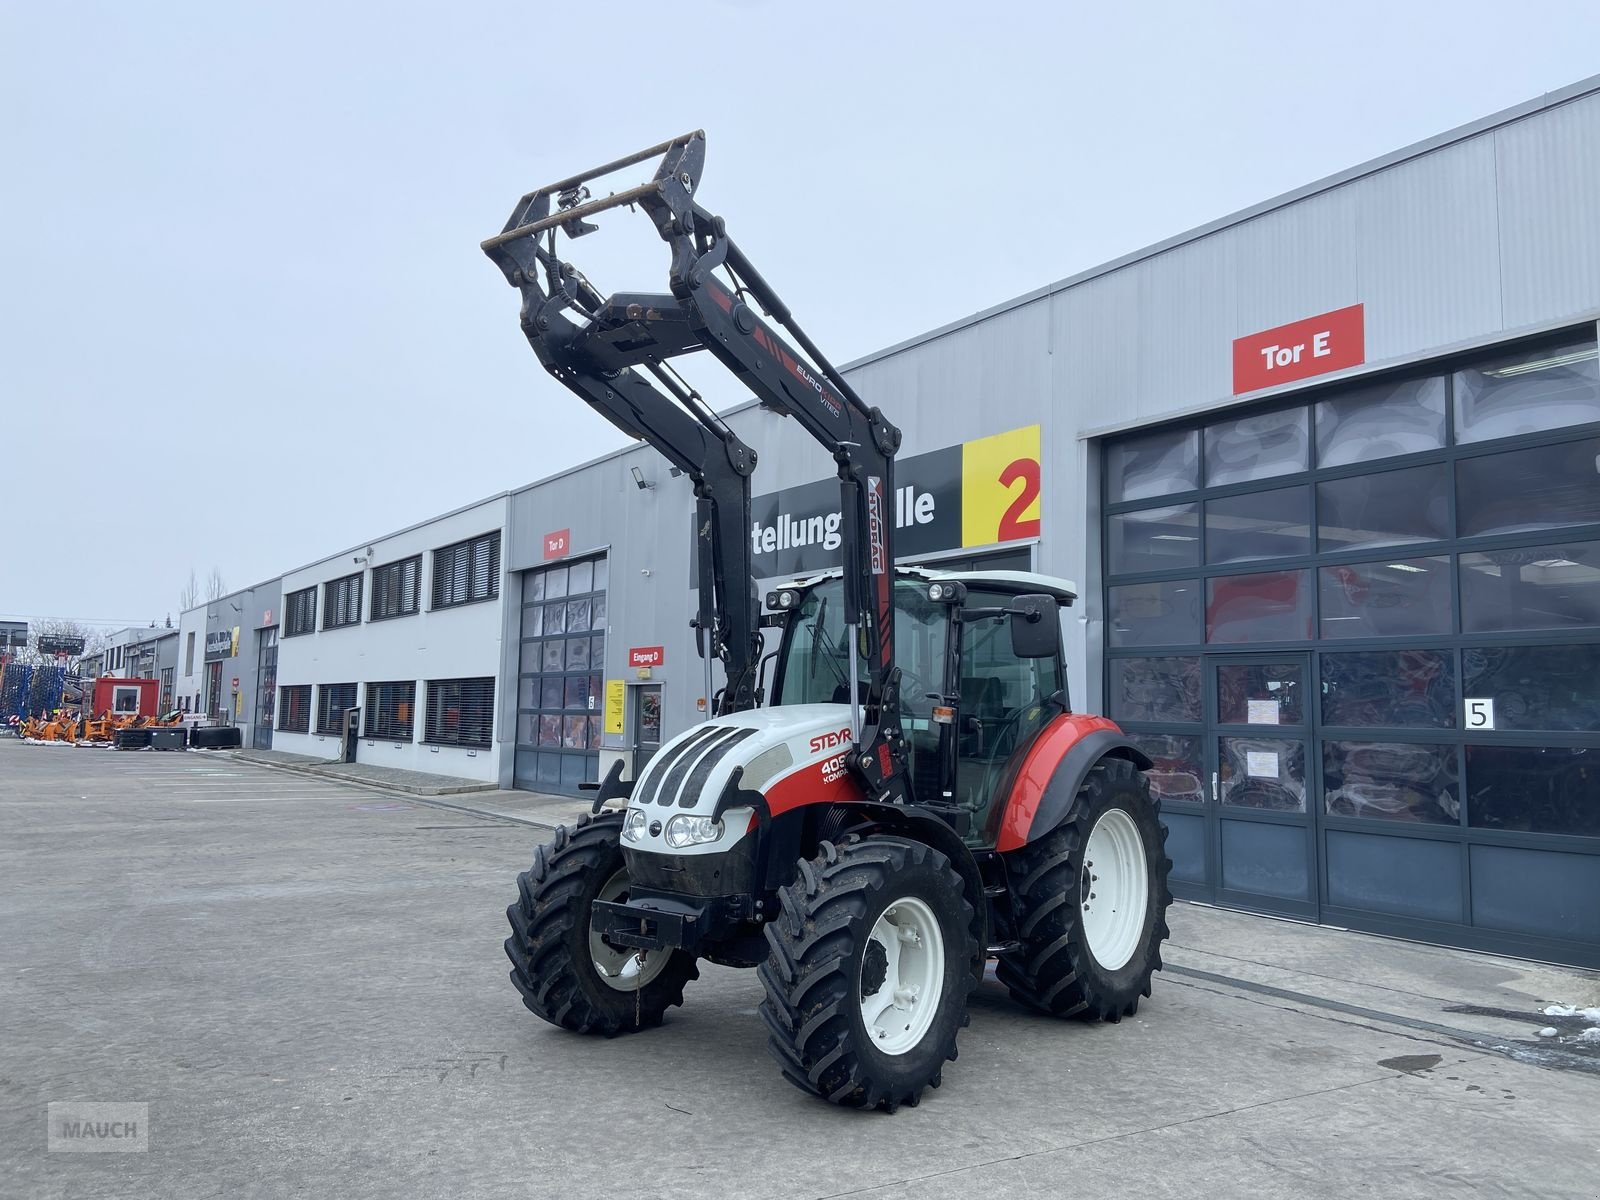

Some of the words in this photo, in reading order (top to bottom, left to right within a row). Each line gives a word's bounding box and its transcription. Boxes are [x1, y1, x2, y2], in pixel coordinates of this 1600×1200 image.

[1261, 344, 1304, 370] Tor
[1313, 331, 1331, 358] E
[751, 511, 842, 554] tellung
[896, 485, 935, 528] lle
[998, 457, 1040, 542] 2
[869, 492, 880, 569] HYDRAC
[549, 540, 558, 552] Tor
[633, 652, 654, 663] Eingang
[1471, 703, 1487, 726] 5
[809, 728, 852, 753] STEYR
[821, 755, 846, 774] 409
[823, 769, 849, 785] KOMPA
